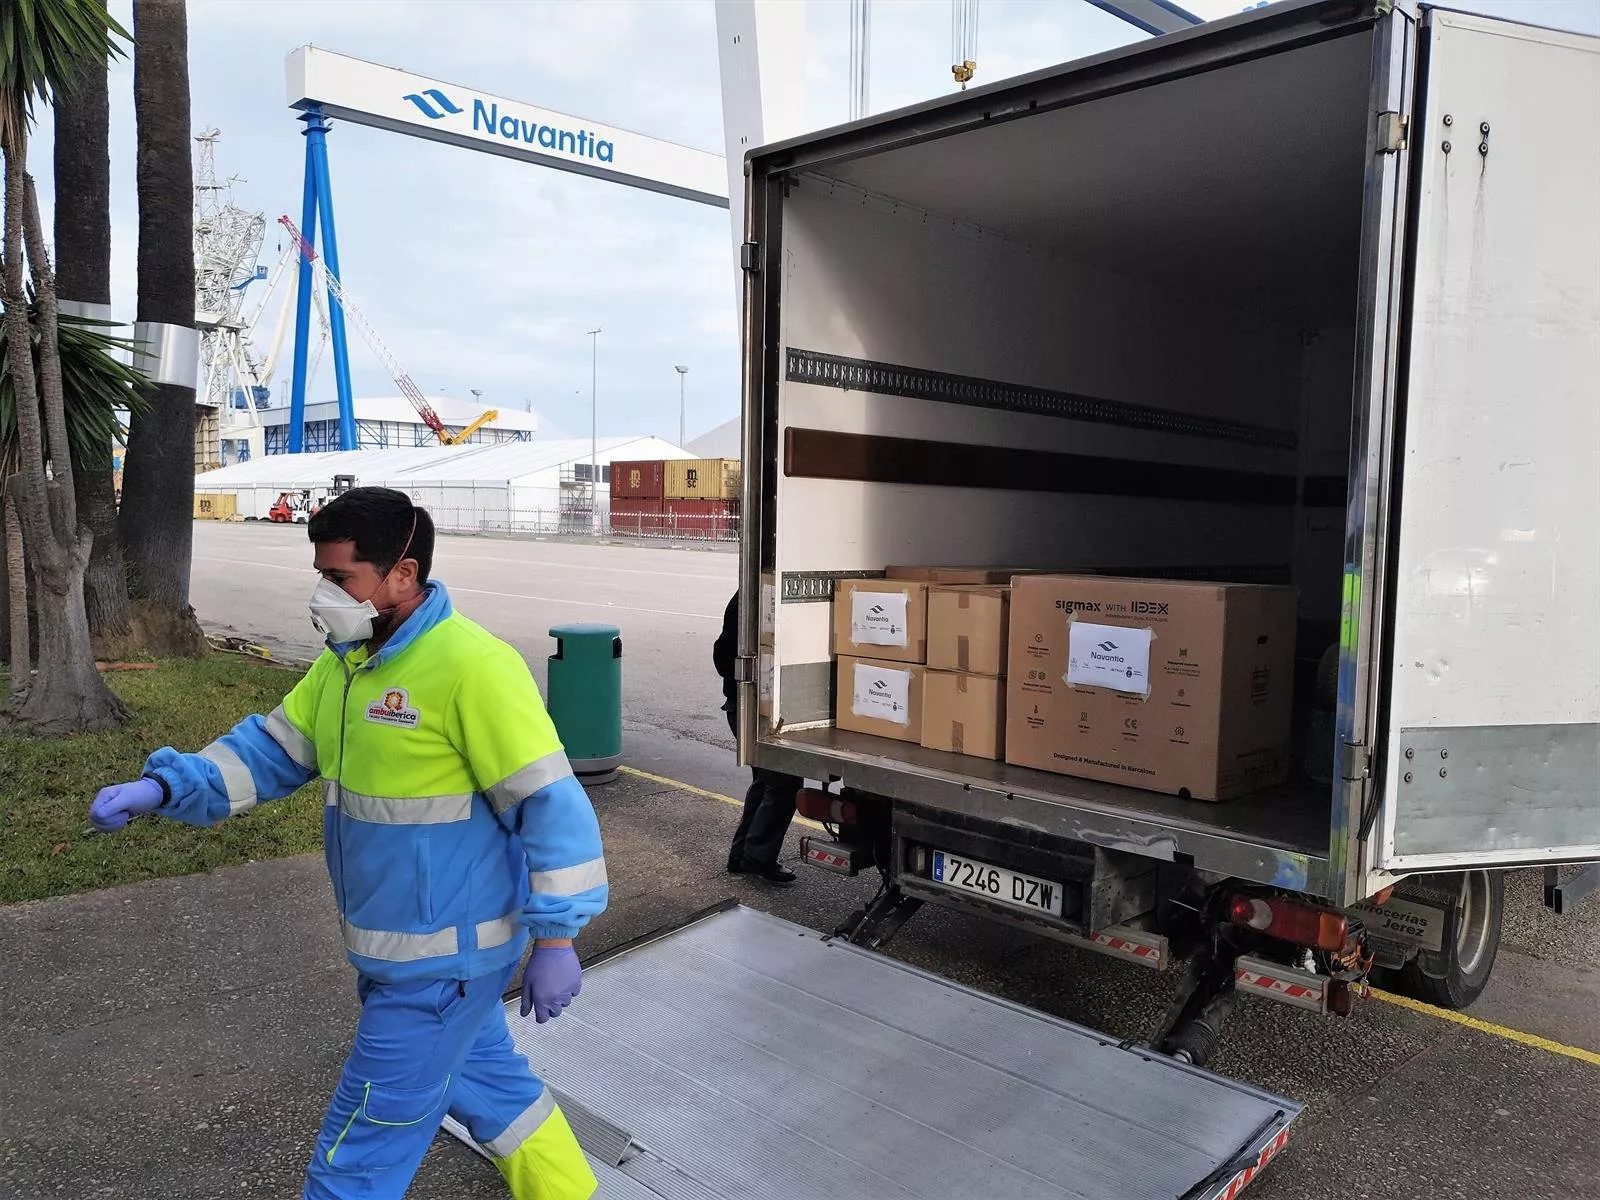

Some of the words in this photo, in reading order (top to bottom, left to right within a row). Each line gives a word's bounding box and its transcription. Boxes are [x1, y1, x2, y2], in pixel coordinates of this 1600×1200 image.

[473, 98, 614, 163] Navantia
[1055, 599, 1101, 615] sigmax
[1105, 603, 1127, 612] WITH
[1091, 651, 1124, 663] Navantia
[869, 688, 892, 698] Navantia
[1053, 752, 1080, 762] Designed
[1083, 757, 1120, 770] Manufactured
[1127, 765, 1156, 776] Barcelona
[949, 858, 1000, 894] 7246
[1012, 875, 1053, 911] DZW
[1351, 902, 1429, 927] arrocerias
[1382, 918, 1425, 937] Jerez
